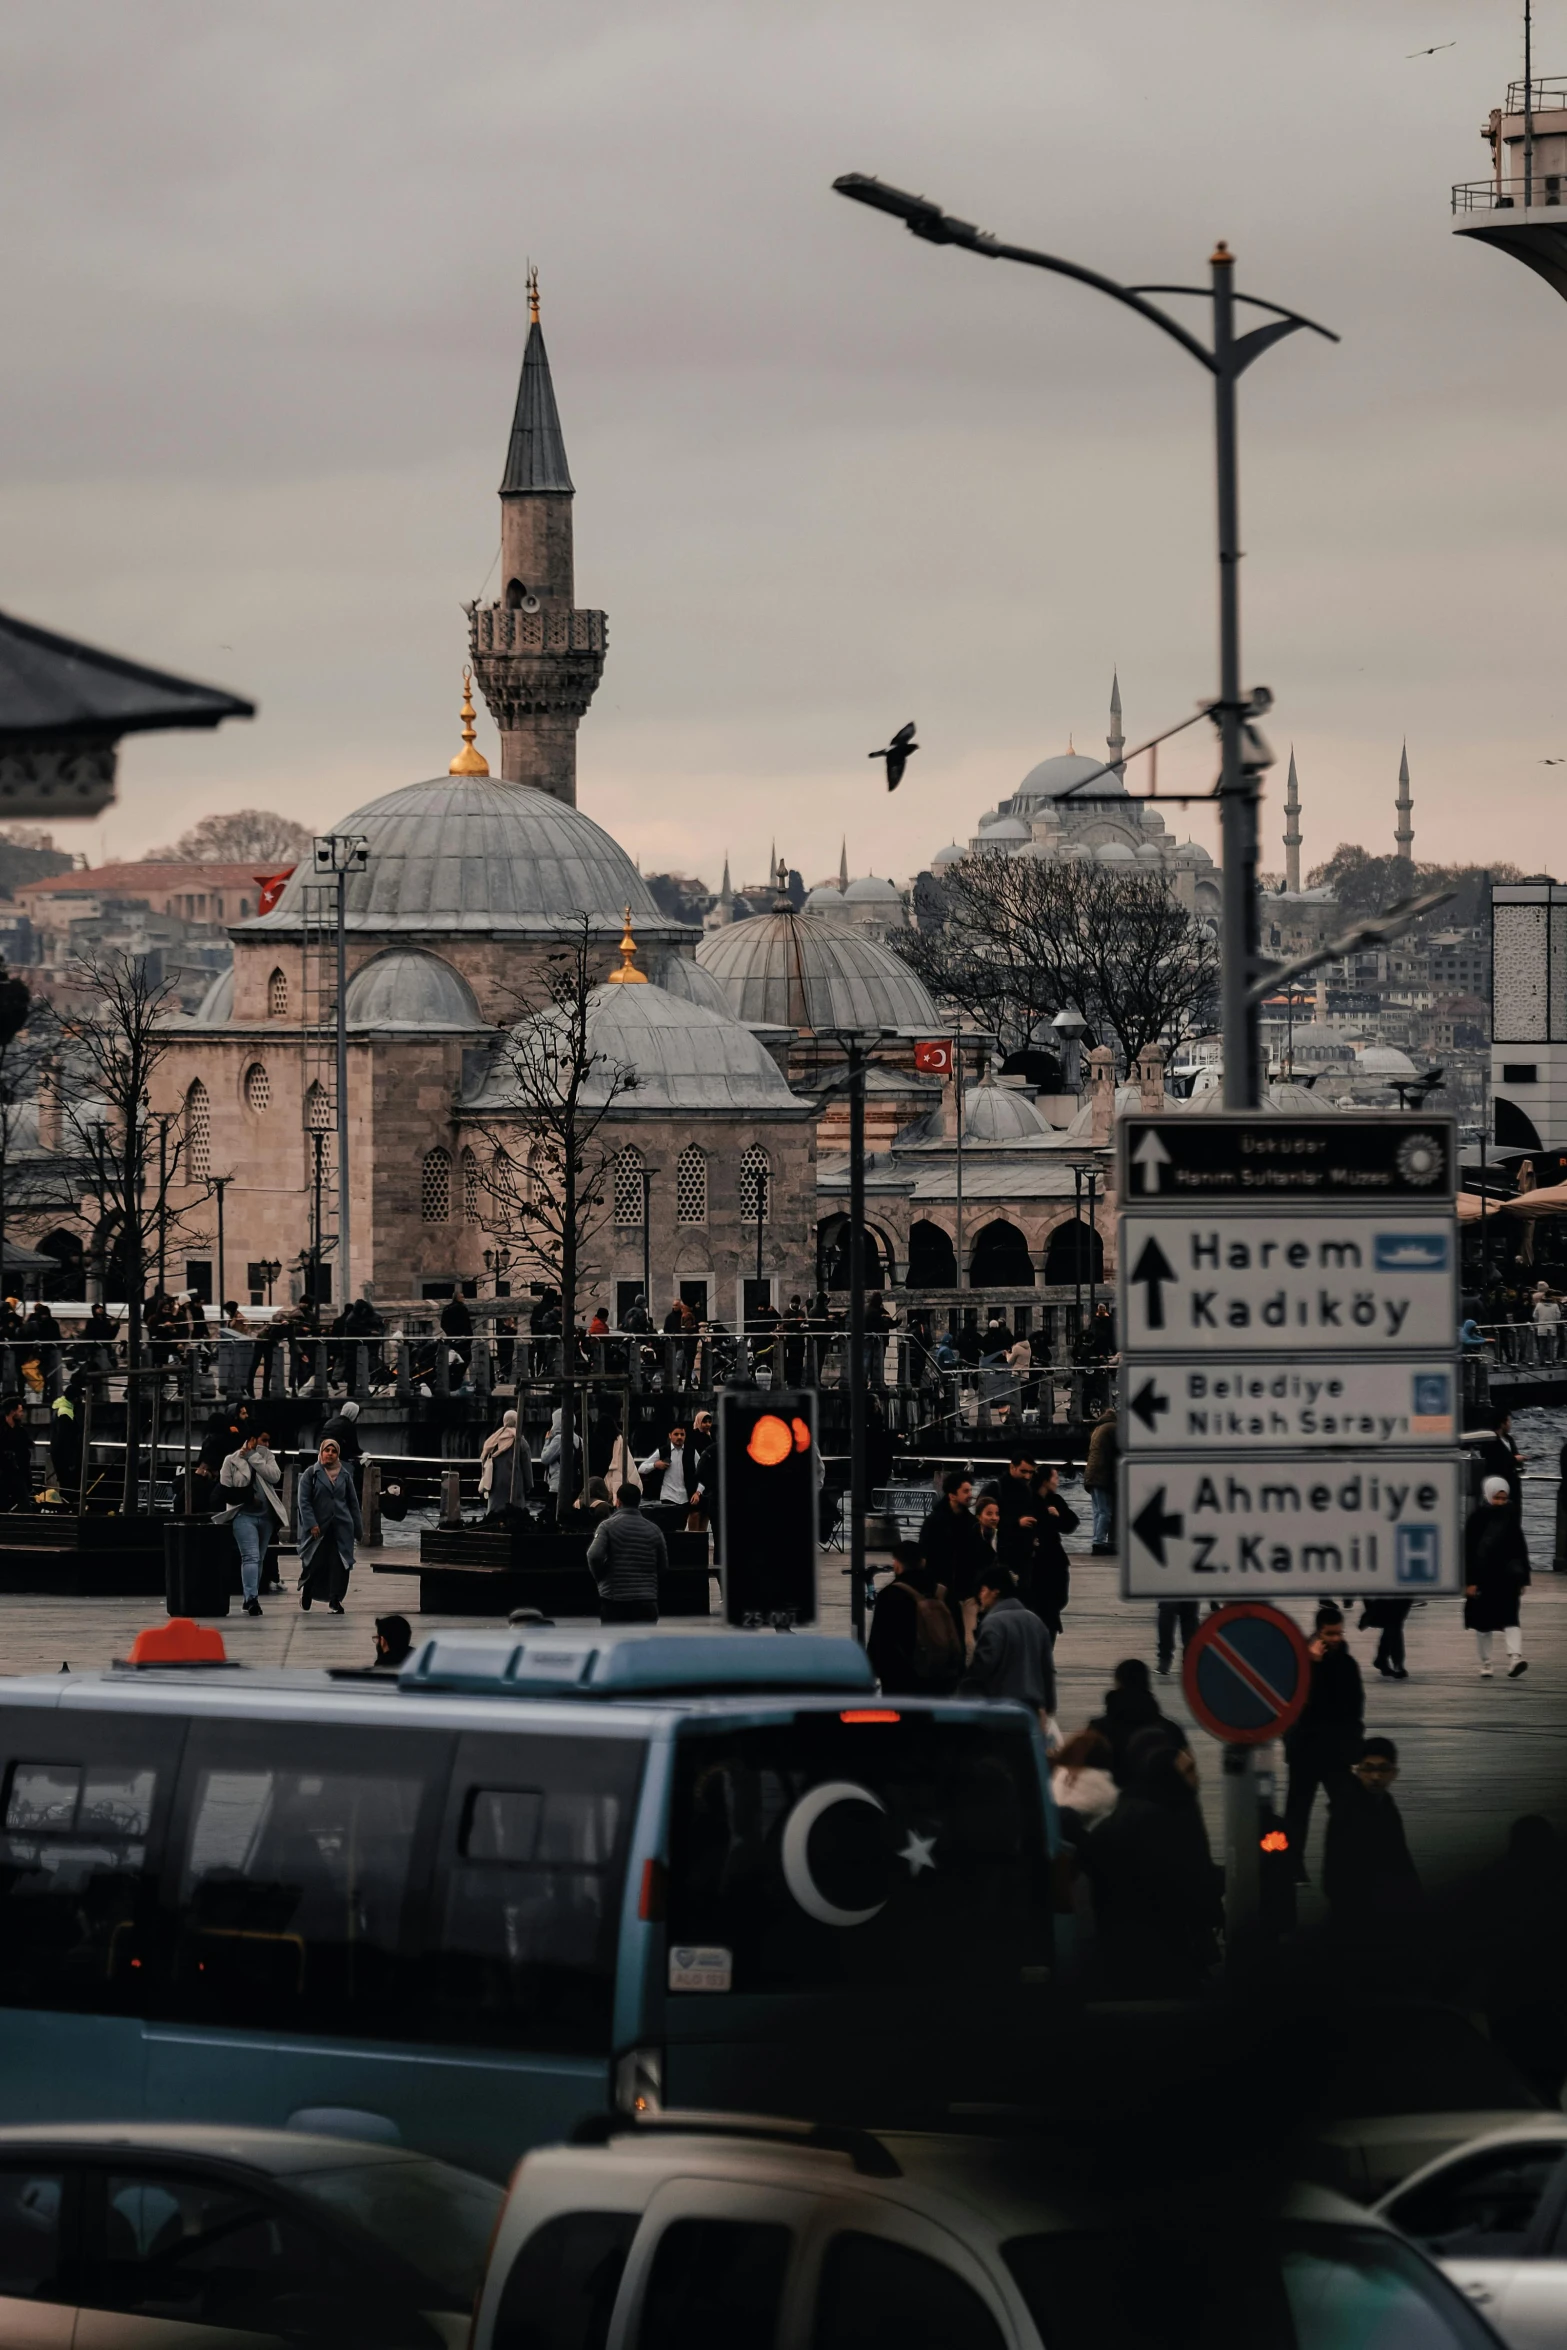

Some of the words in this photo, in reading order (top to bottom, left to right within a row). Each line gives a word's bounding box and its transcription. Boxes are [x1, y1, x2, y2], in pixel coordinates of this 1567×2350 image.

[1240, 1168, 1324, 1186] Sultanlar
[1190, 1231, 1362, 1270] Harem
[1190, 1288, 1411, 1338] Kadıköy
[1187, 1372, 1343, 1405] Belediye
[1187, 1411, 1287, 1435] Nikah
[1299, 1410, 1408, 1441] Sarayı
[1192, 1474, 1439, 1522] Ahmediye
[1190, 1535, 1377, 1573] Z.Kamil
